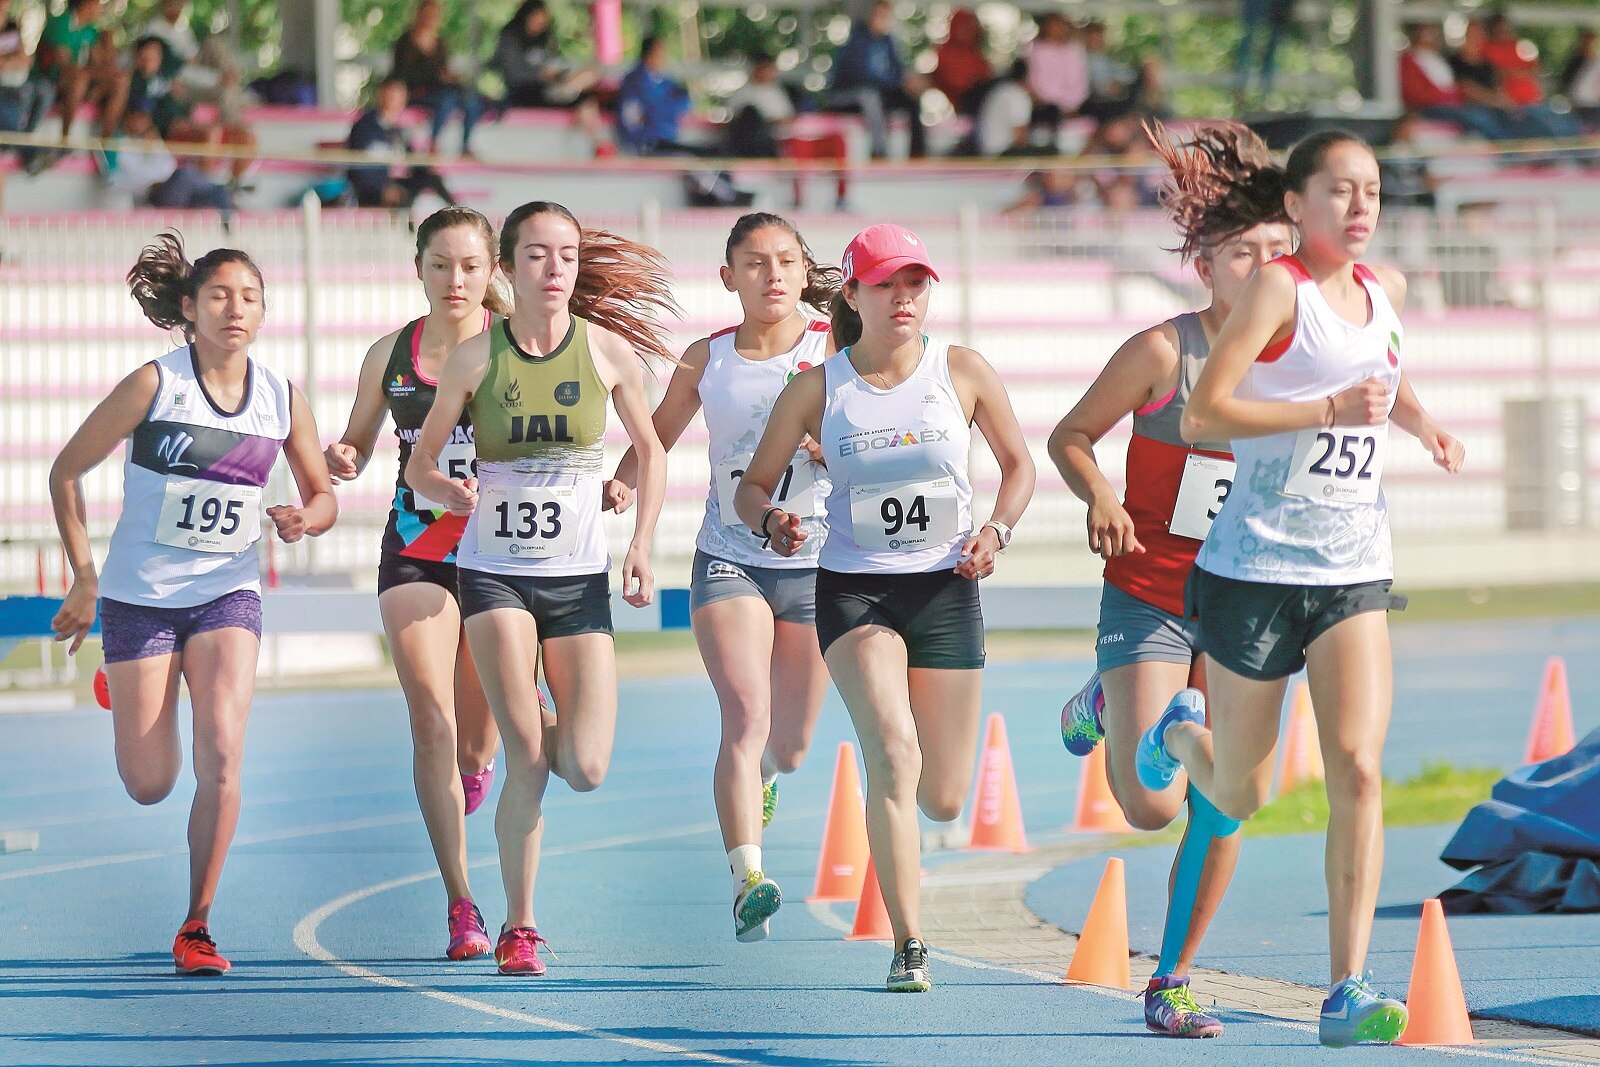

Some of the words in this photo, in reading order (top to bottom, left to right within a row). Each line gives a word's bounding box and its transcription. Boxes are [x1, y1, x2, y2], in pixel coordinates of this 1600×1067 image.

[508, 414, 574, 444] JAL
[157, 431, 199, 471] NL
[1309, 432, 1376, 481] 252
[176, 494, 244, 535] 195
[494, 501, 562, 539] 133
[880, 495, 931, 536] 94
[1099, 633, 1125, 645] VERSA
